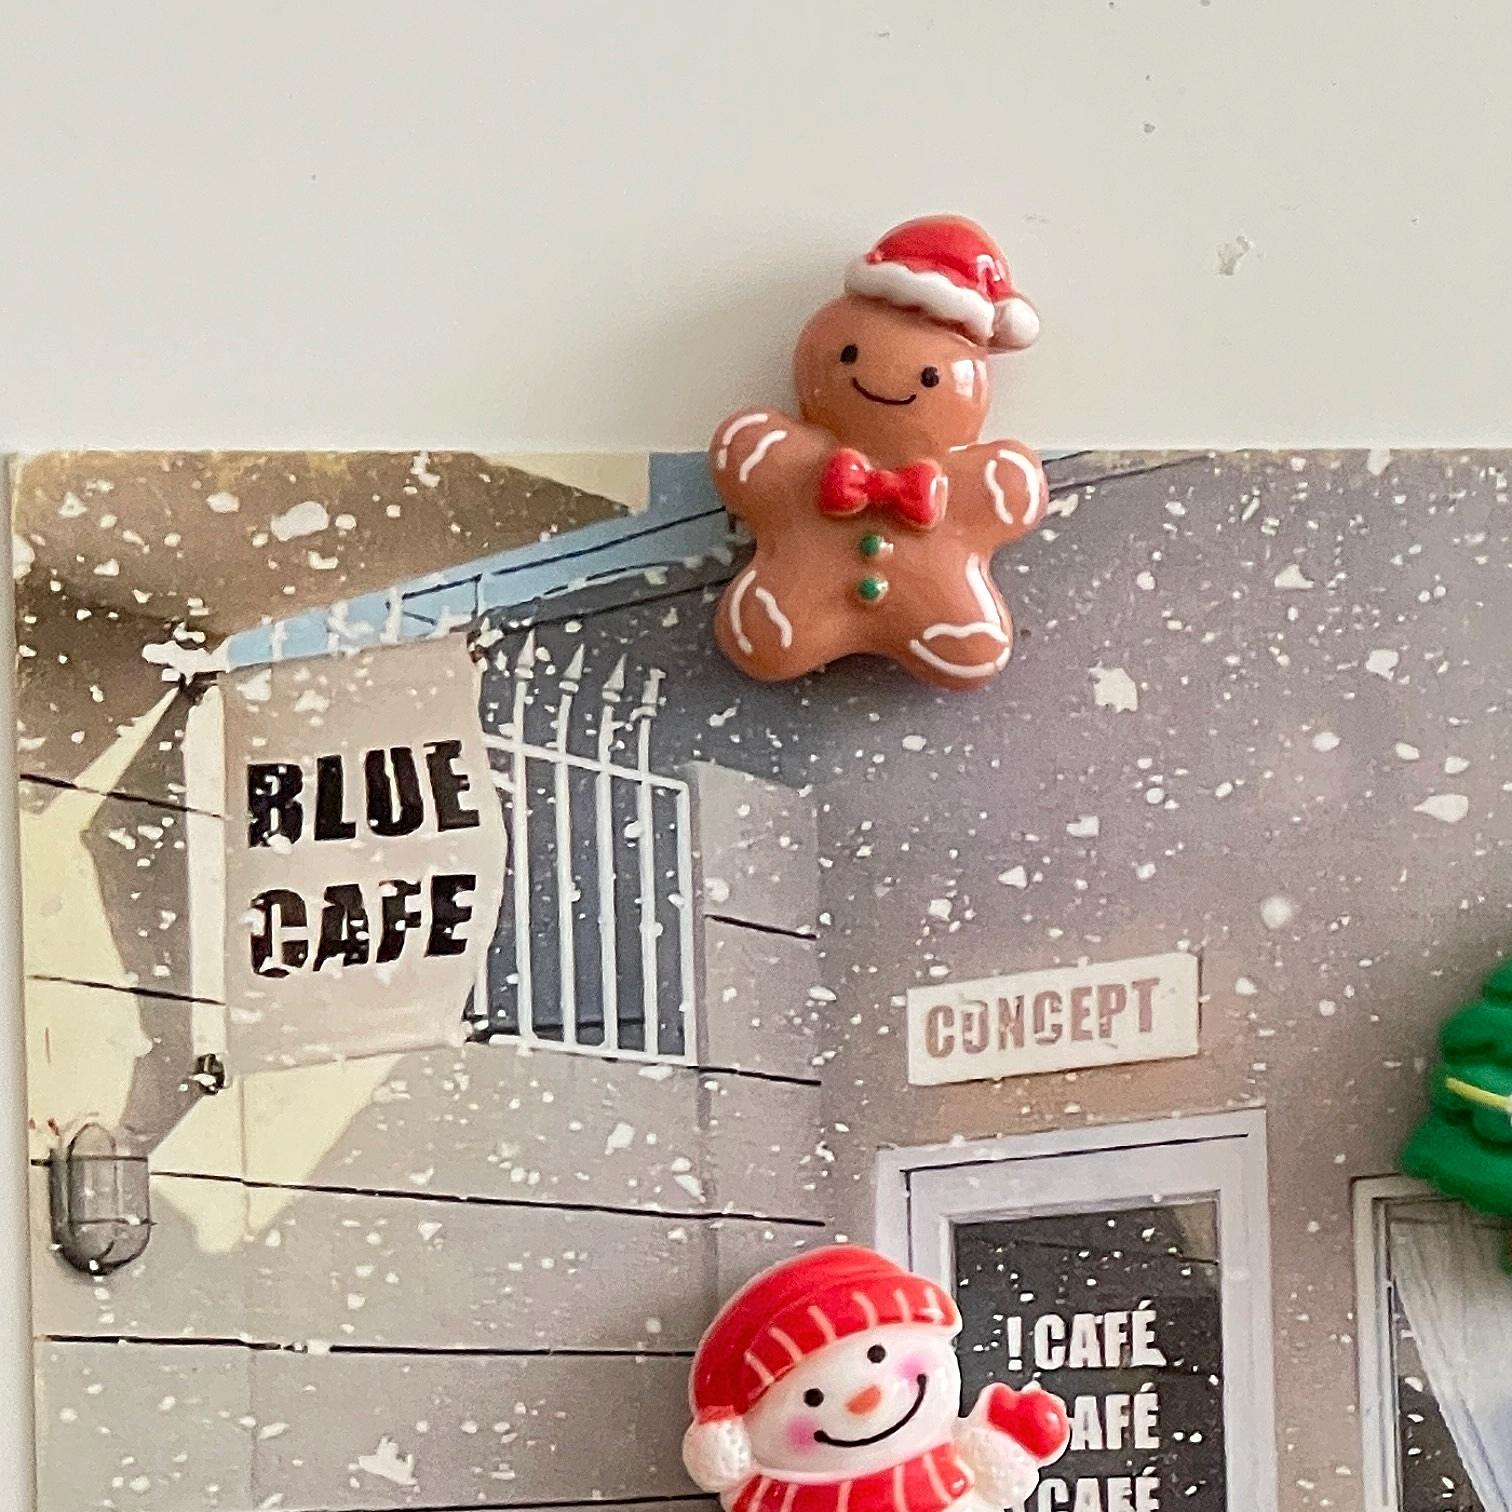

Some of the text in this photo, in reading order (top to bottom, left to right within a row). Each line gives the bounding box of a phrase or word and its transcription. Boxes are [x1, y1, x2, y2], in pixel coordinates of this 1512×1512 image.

[246, 739, 481, 849] BLUE
[249, 874, 477, 979] CAFE
[925, 977, 1161, 1058] CONCEPT
[1069, 1383, 1160, 1450] AFÉ
